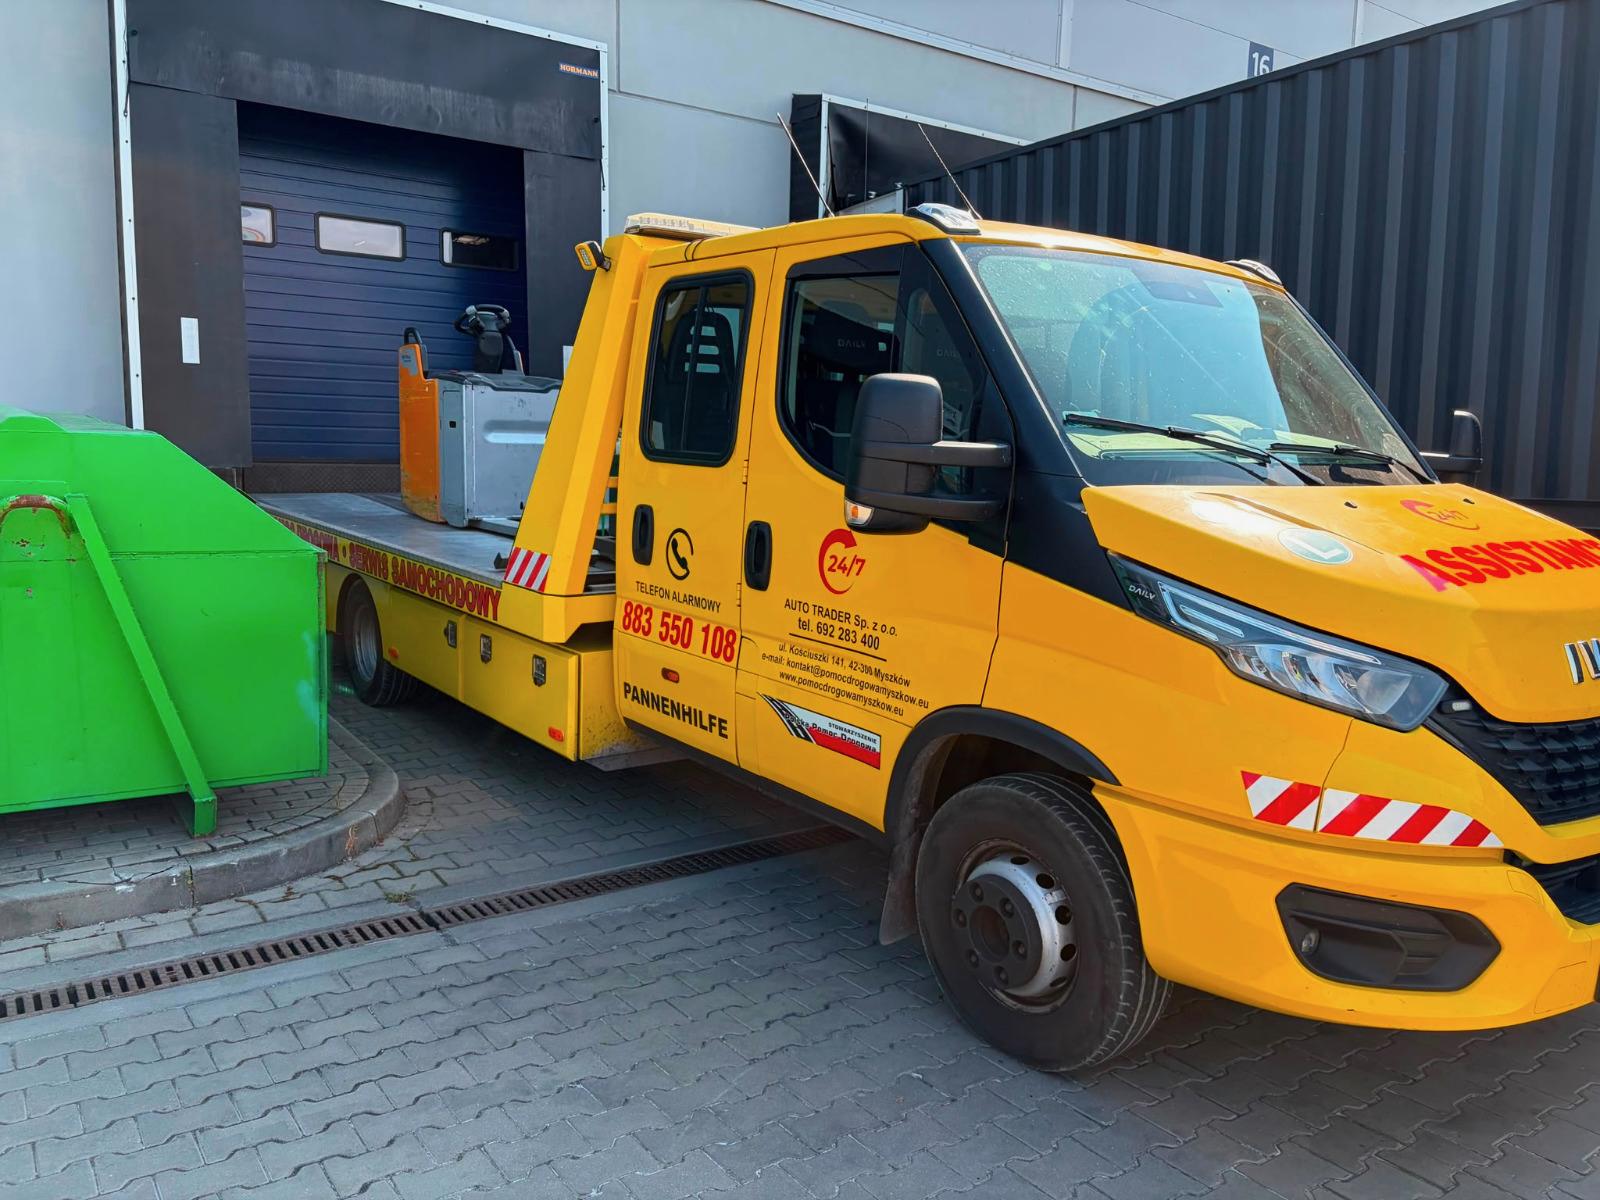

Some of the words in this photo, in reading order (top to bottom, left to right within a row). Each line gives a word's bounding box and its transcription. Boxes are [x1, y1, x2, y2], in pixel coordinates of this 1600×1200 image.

[1252, 52, 1270, 77] 16
[349, 542, 388, 581] SERWIS
[392, 556, 501, 621] SAMOCHODOWY
[827, 554, 866, 577] 24/7
[636, 581, 670, 600] TELEFON
[672, 590, 721, 613] ALARMOWY
[1128, 585, 1156, 600] DAILY
[622, 601, 653, 637] 883
[659, 611, 693, 649] 550
[701, 623, 737, 662] 108
[784, 598, 810, 614] AUTO
[812, 604, 851, 624] TRADER
[854, 614, 869, 630] Sp.
[872, 621, 878, 631] z
[880, 623, 898, 637] o.o.
[798, 617, 813, 632] tel.
[816, 621, 835, 638] 692
[838, 627, 857, 644] 283
[860, 633, 880, 650] 400
[761, 652, 785, 665] e-mail:
[786, 658, 929, 709] kontakt@pomocdrogowamyszkow.eu
[778, 643, 787, 652] ul.
[789, 643, 829, 663] Kościuszki
[831, 655, 847, 669] 141,
[848, 660, 873, 675] 42-300
[874, 664, 910, 687] Myszków
[623, 681, 729, 740] PANNENHILFE
[779, 671, 904, 717] www.pomocdrogowamyszkow.eu
[811, 722, 838, 738] Pomoc
[840, 732, 878, 753] Drogowa
[828, 722, 878, 745] STOWARZYSZENIE
